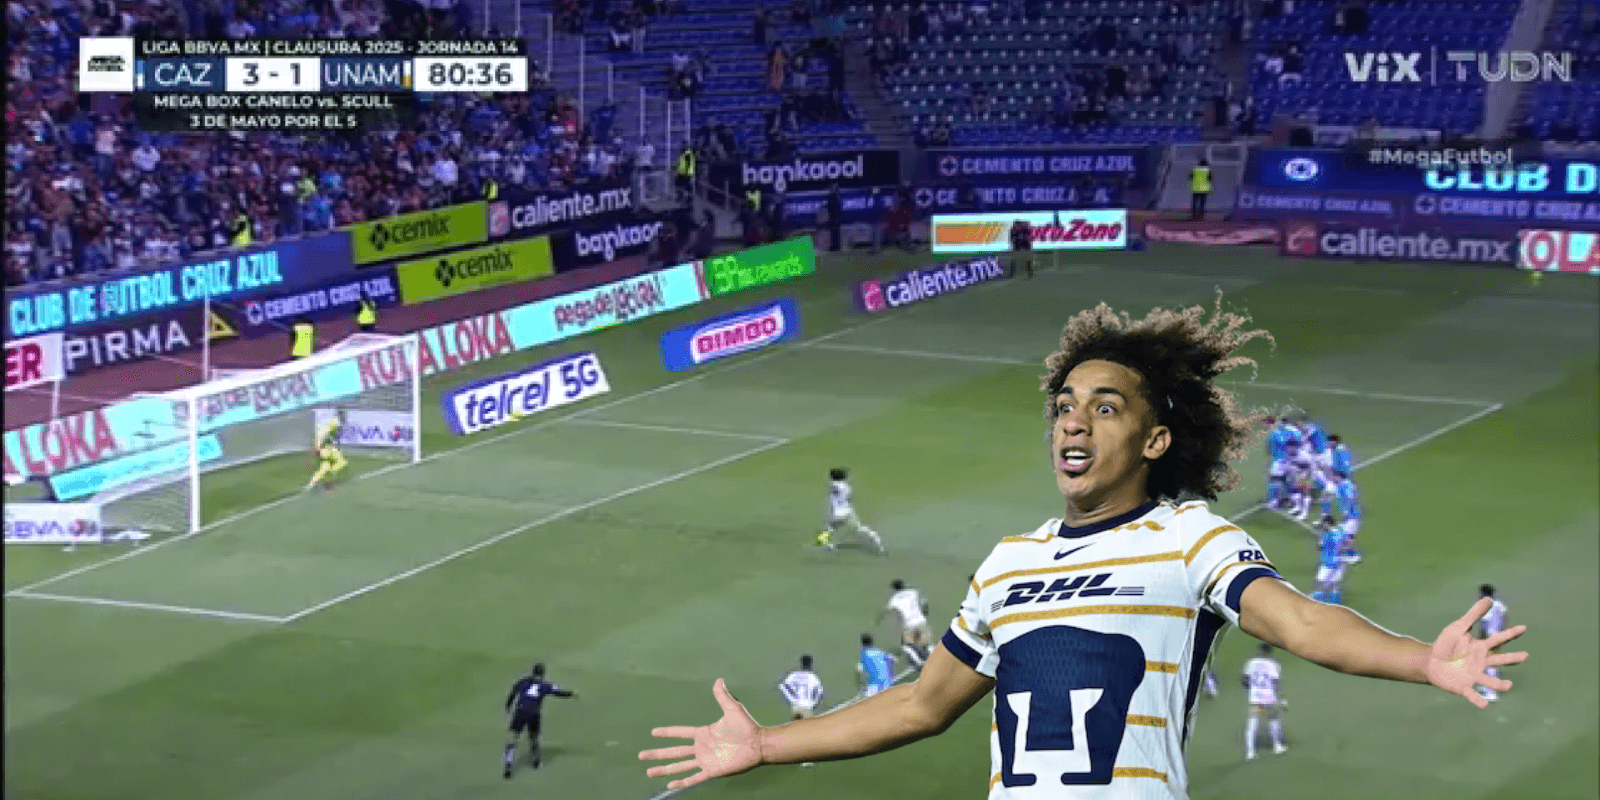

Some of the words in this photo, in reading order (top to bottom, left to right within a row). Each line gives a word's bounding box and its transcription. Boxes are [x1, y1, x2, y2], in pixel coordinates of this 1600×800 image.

[963, 156, 1045, 173] CEMENTO
[1050, 156, 1092, 172] CRUZ
[1425, 163, 1549, 191] CLUB
[512, 187, 631, 228] caliente.mx
[1320, 227, 1511, 262] caliente.mx
[457, 248, 513, 278] cemix
[10, 293, 64, 336] CLUB
[69, 286, 97, 322] DE
[181, 259, 232, 299] CRUZ
[237, 250, 283, 291] AZUL
[66, 320, 190, 370] PIRMA
[697, 316, 778, 352] BIMBO
[560, 359, 599, 397] 5G
[1003, 573, 1119, 607] DHL
